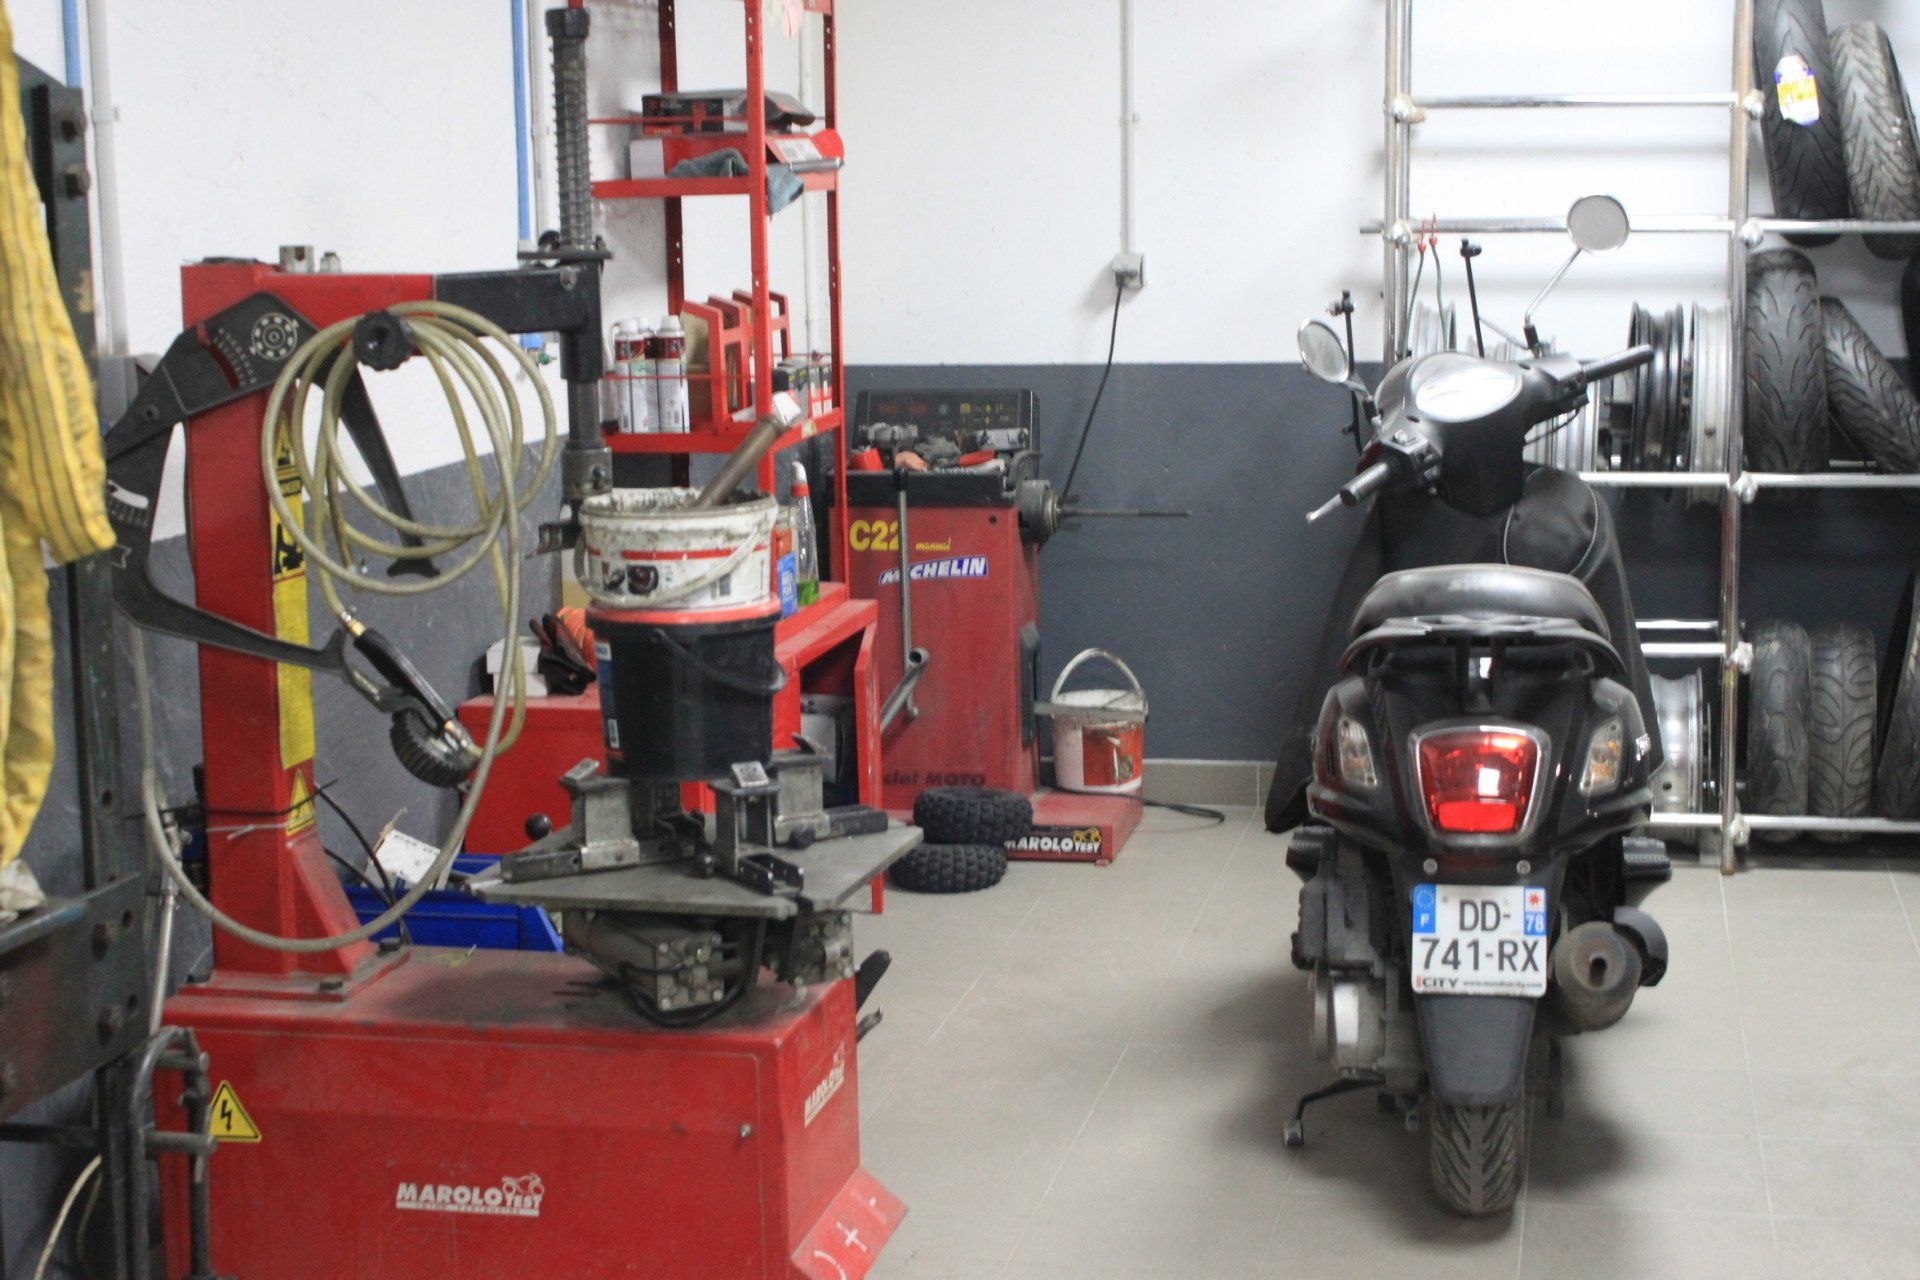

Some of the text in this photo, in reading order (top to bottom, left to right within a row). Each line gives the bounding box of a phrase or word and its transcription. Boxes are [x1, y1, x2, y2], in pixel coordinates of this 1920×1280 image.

[916, 537, 951, 551] manual
[881, 557, 985, 584] MCHELIN
[1420, 914, 1429, 927] F
[1525, 914, 1544, 932] 78
[1421, 938, 1539, 972] 741-RX
